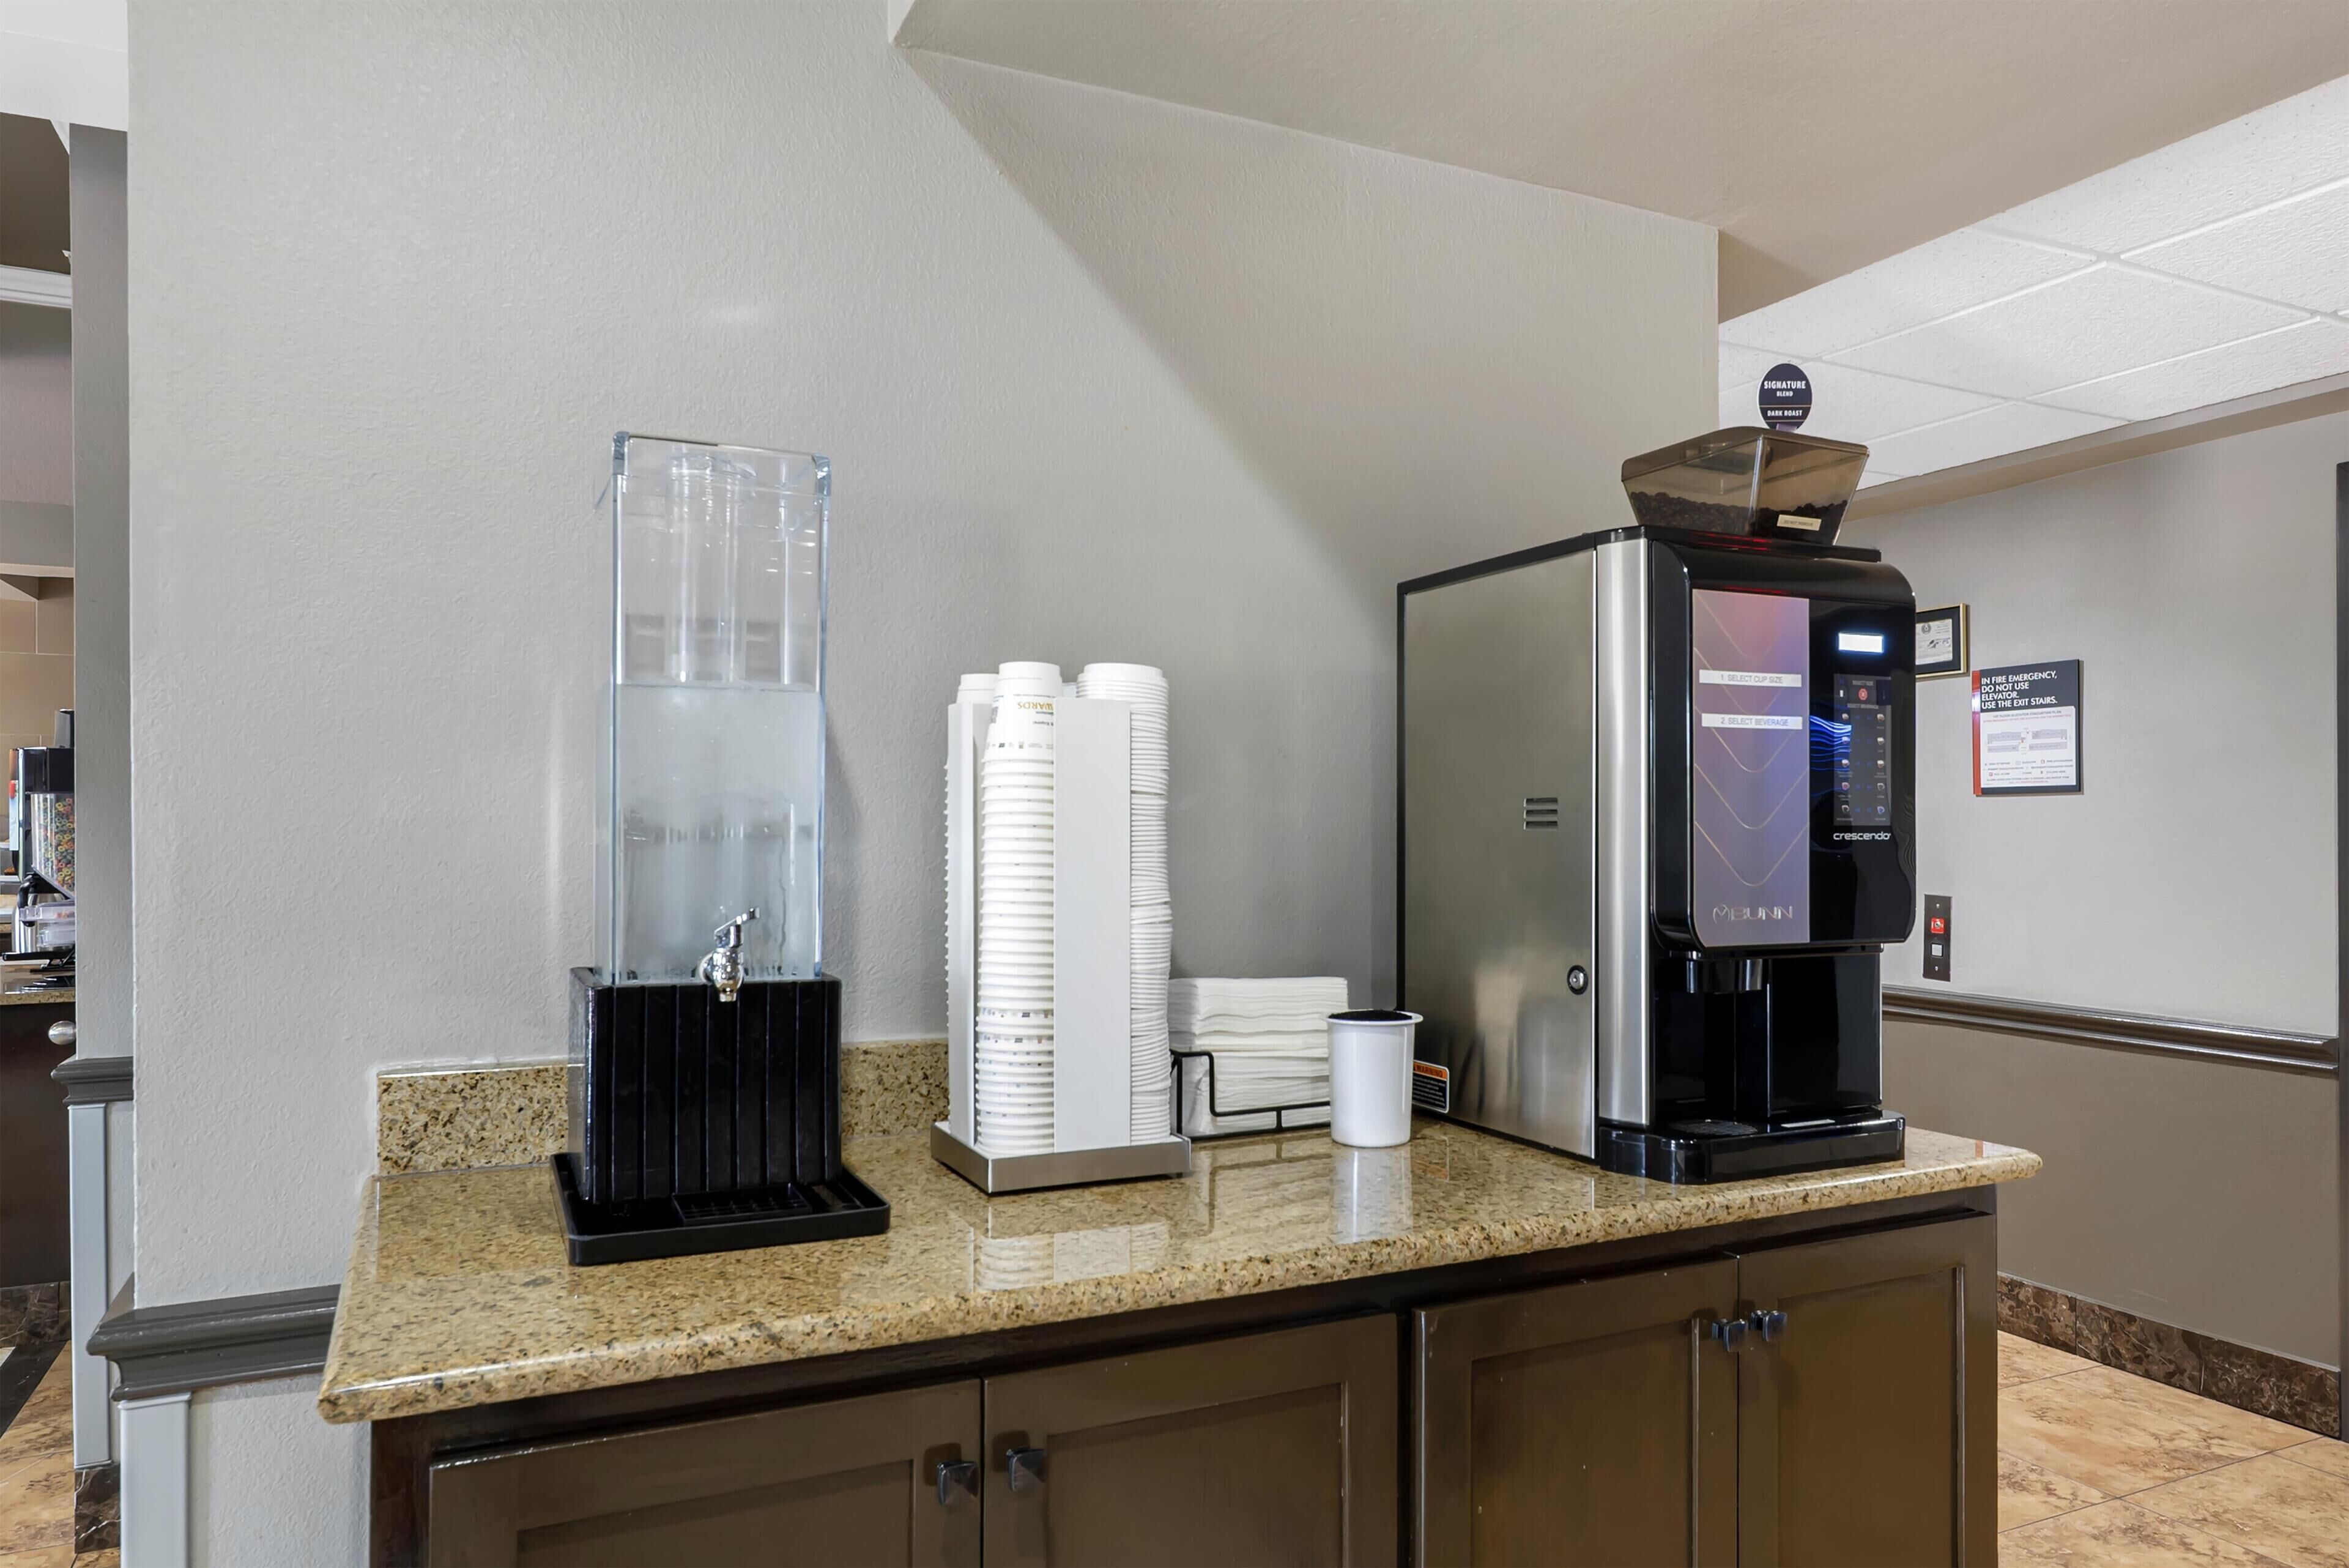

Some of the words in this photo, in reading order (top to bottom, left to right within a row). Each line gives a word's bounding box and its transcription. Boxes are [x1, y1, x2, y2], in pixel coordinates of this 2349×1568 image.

[1764, 381, 1806, 389] SIGNATURE
[2008, 671, 2057, 682] EMERGENCY,
[1981, 691, 2019, 700] ELEVATOR.
[2030, 696, 2058, 705] STAIRS.
[1833, 831, 1890, 840] crescendo
